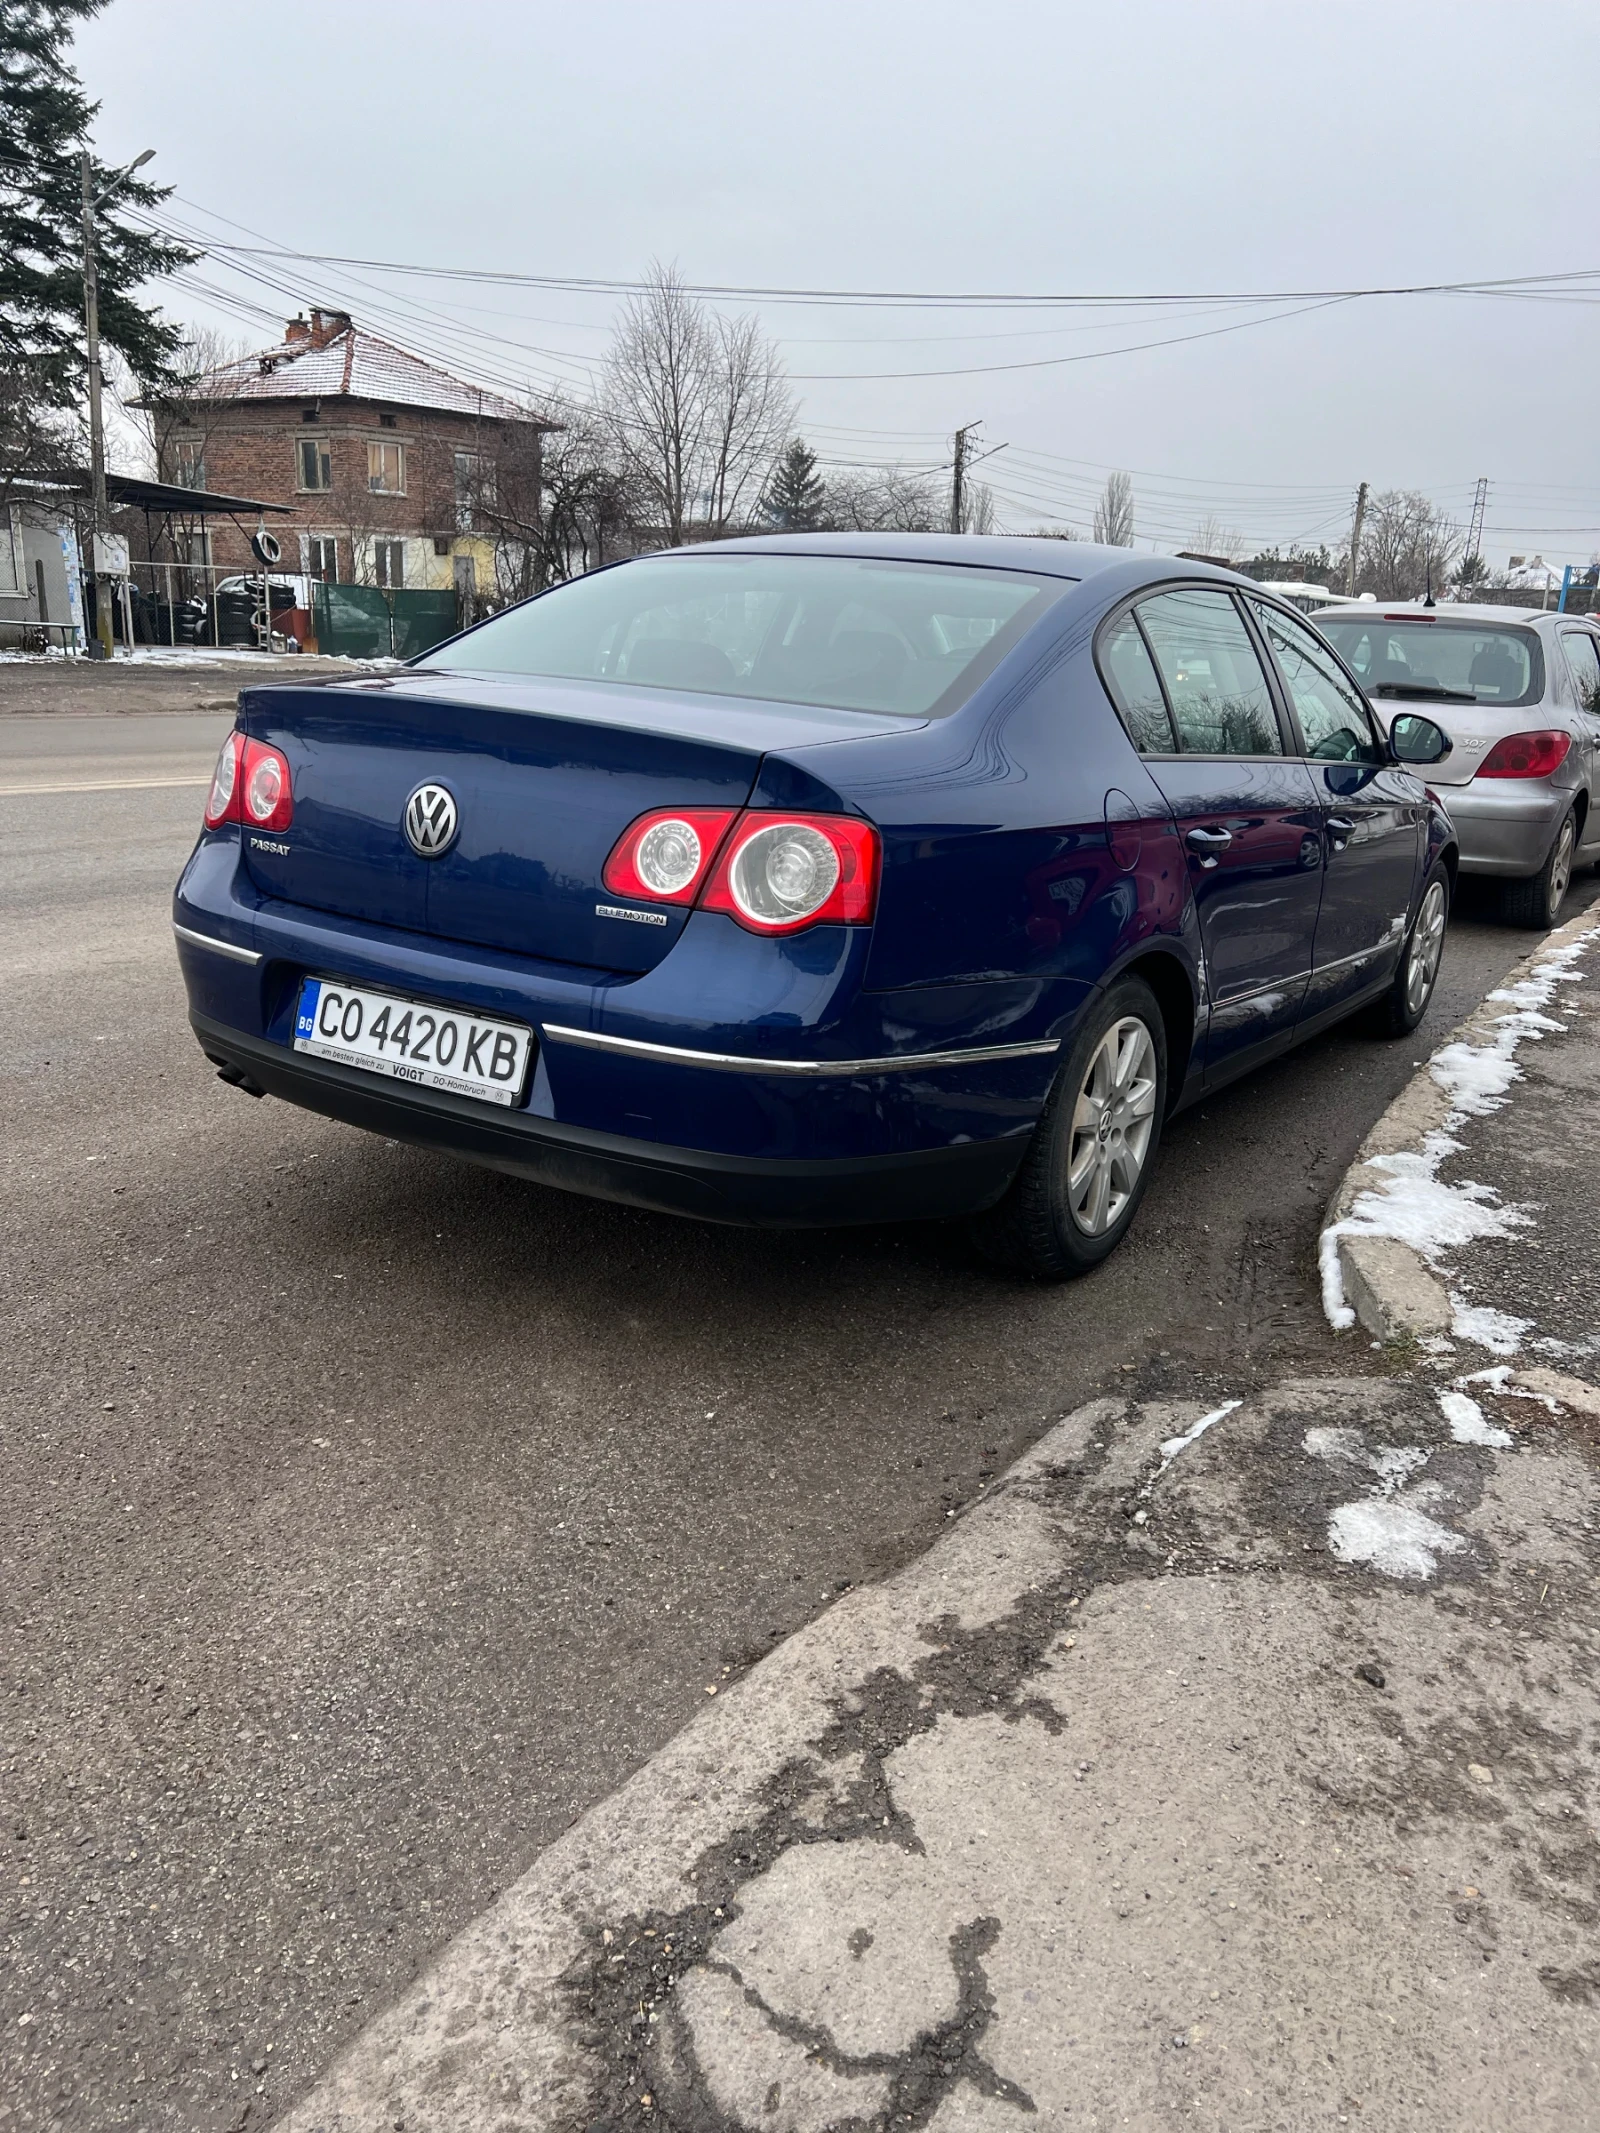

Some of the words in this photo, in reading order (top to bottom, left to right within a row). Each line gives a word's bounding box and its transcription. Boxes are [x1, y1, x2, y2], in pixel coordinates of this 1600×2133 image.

[1459, 739, 1487, 748] 307
[250, 837, 291, 856] PASSAT
[598, 906, 664, 924] BLUEMOTION
[298, 1016, 313, 1031] BG
[319, 993, 364, 1042] CO
[369, 1005, 458, 1066] 4420
[462, 1025, 517, 1081] KB
[321, 1048, 332, 1056] am
[332, 1050, 355, 1062] besten
[355, 1057, 375, 1068] gleich
[393, 1065, 424, 1081] VOIGT
[432, 1076, 486, 1096] DO-Hombruch
